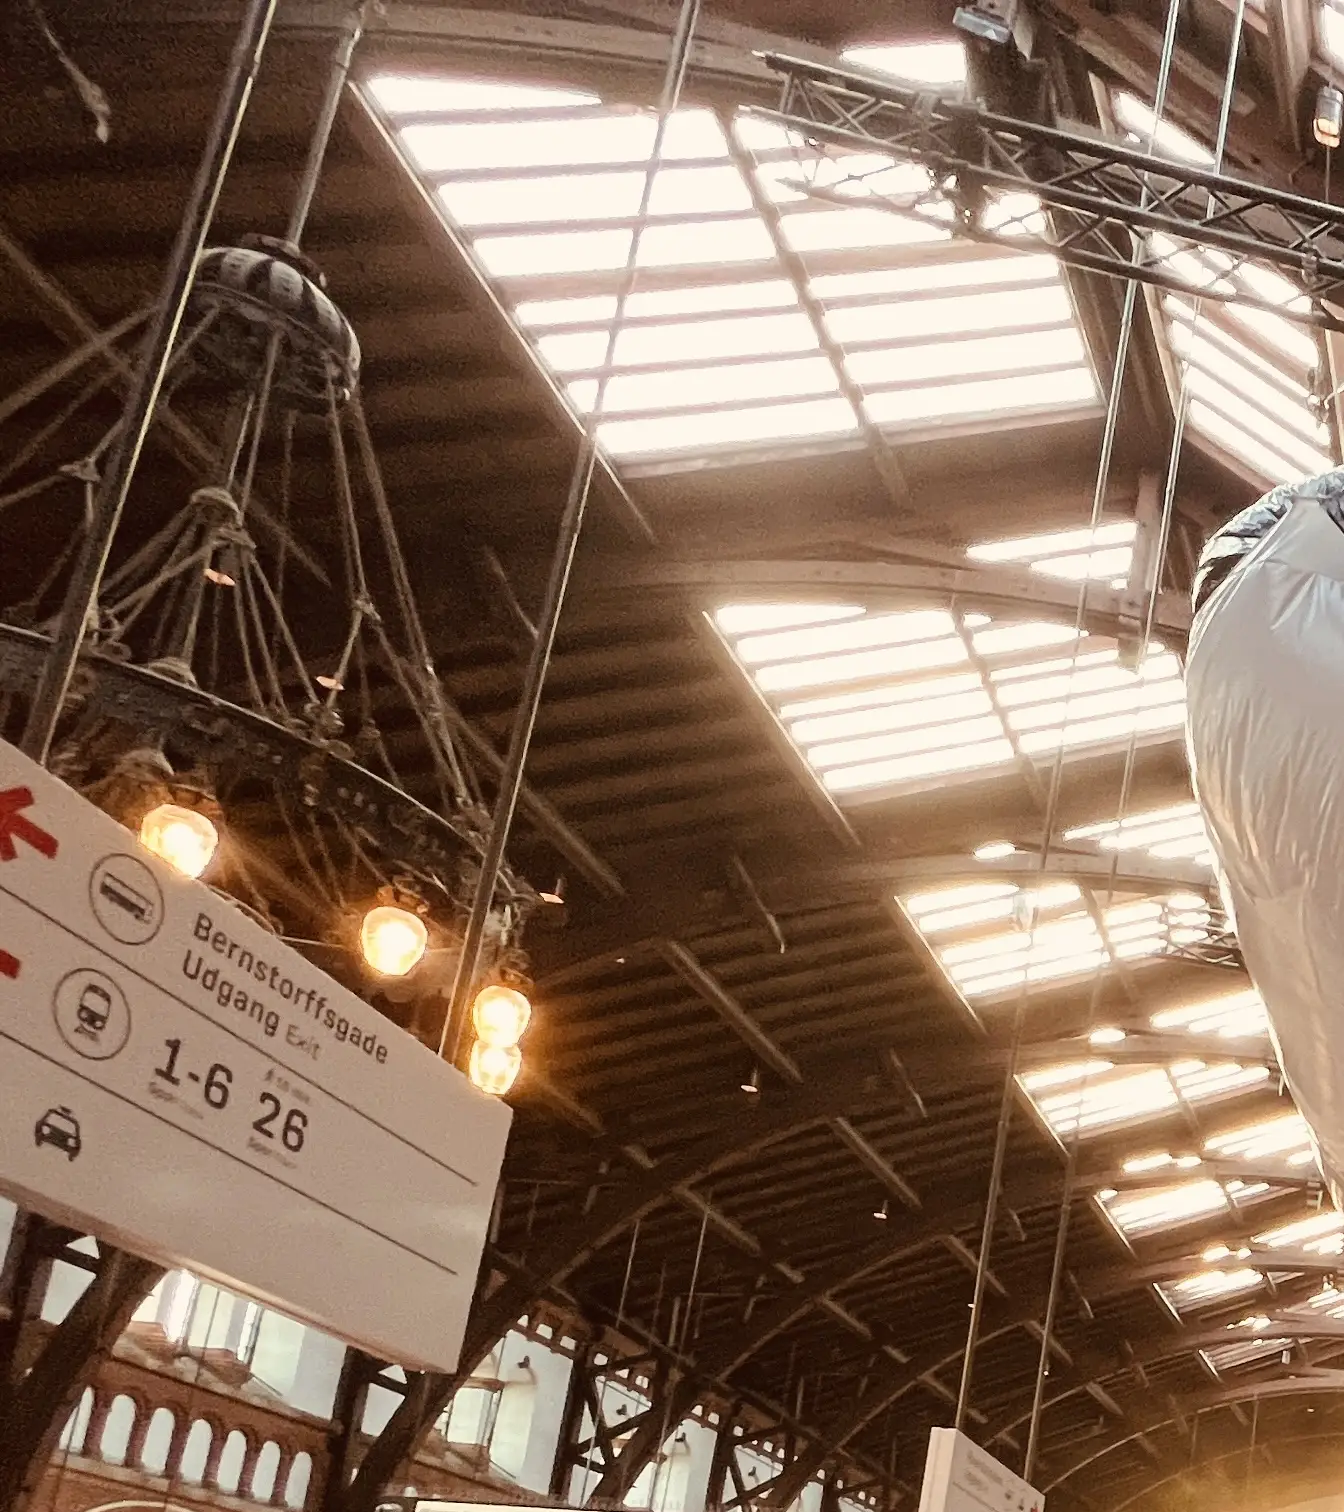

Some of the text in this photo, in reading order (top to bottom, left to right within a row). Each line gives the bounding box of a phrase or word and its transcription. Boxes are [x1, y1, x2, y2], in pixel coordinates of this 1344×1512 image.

[182, 949, 280, 1037] Udgang
[194, 912, 388, 1064] Bernstorffsgade
[155, 1038, 233, 1109] 1-6
[252, 1092, 308, 1152] 26
